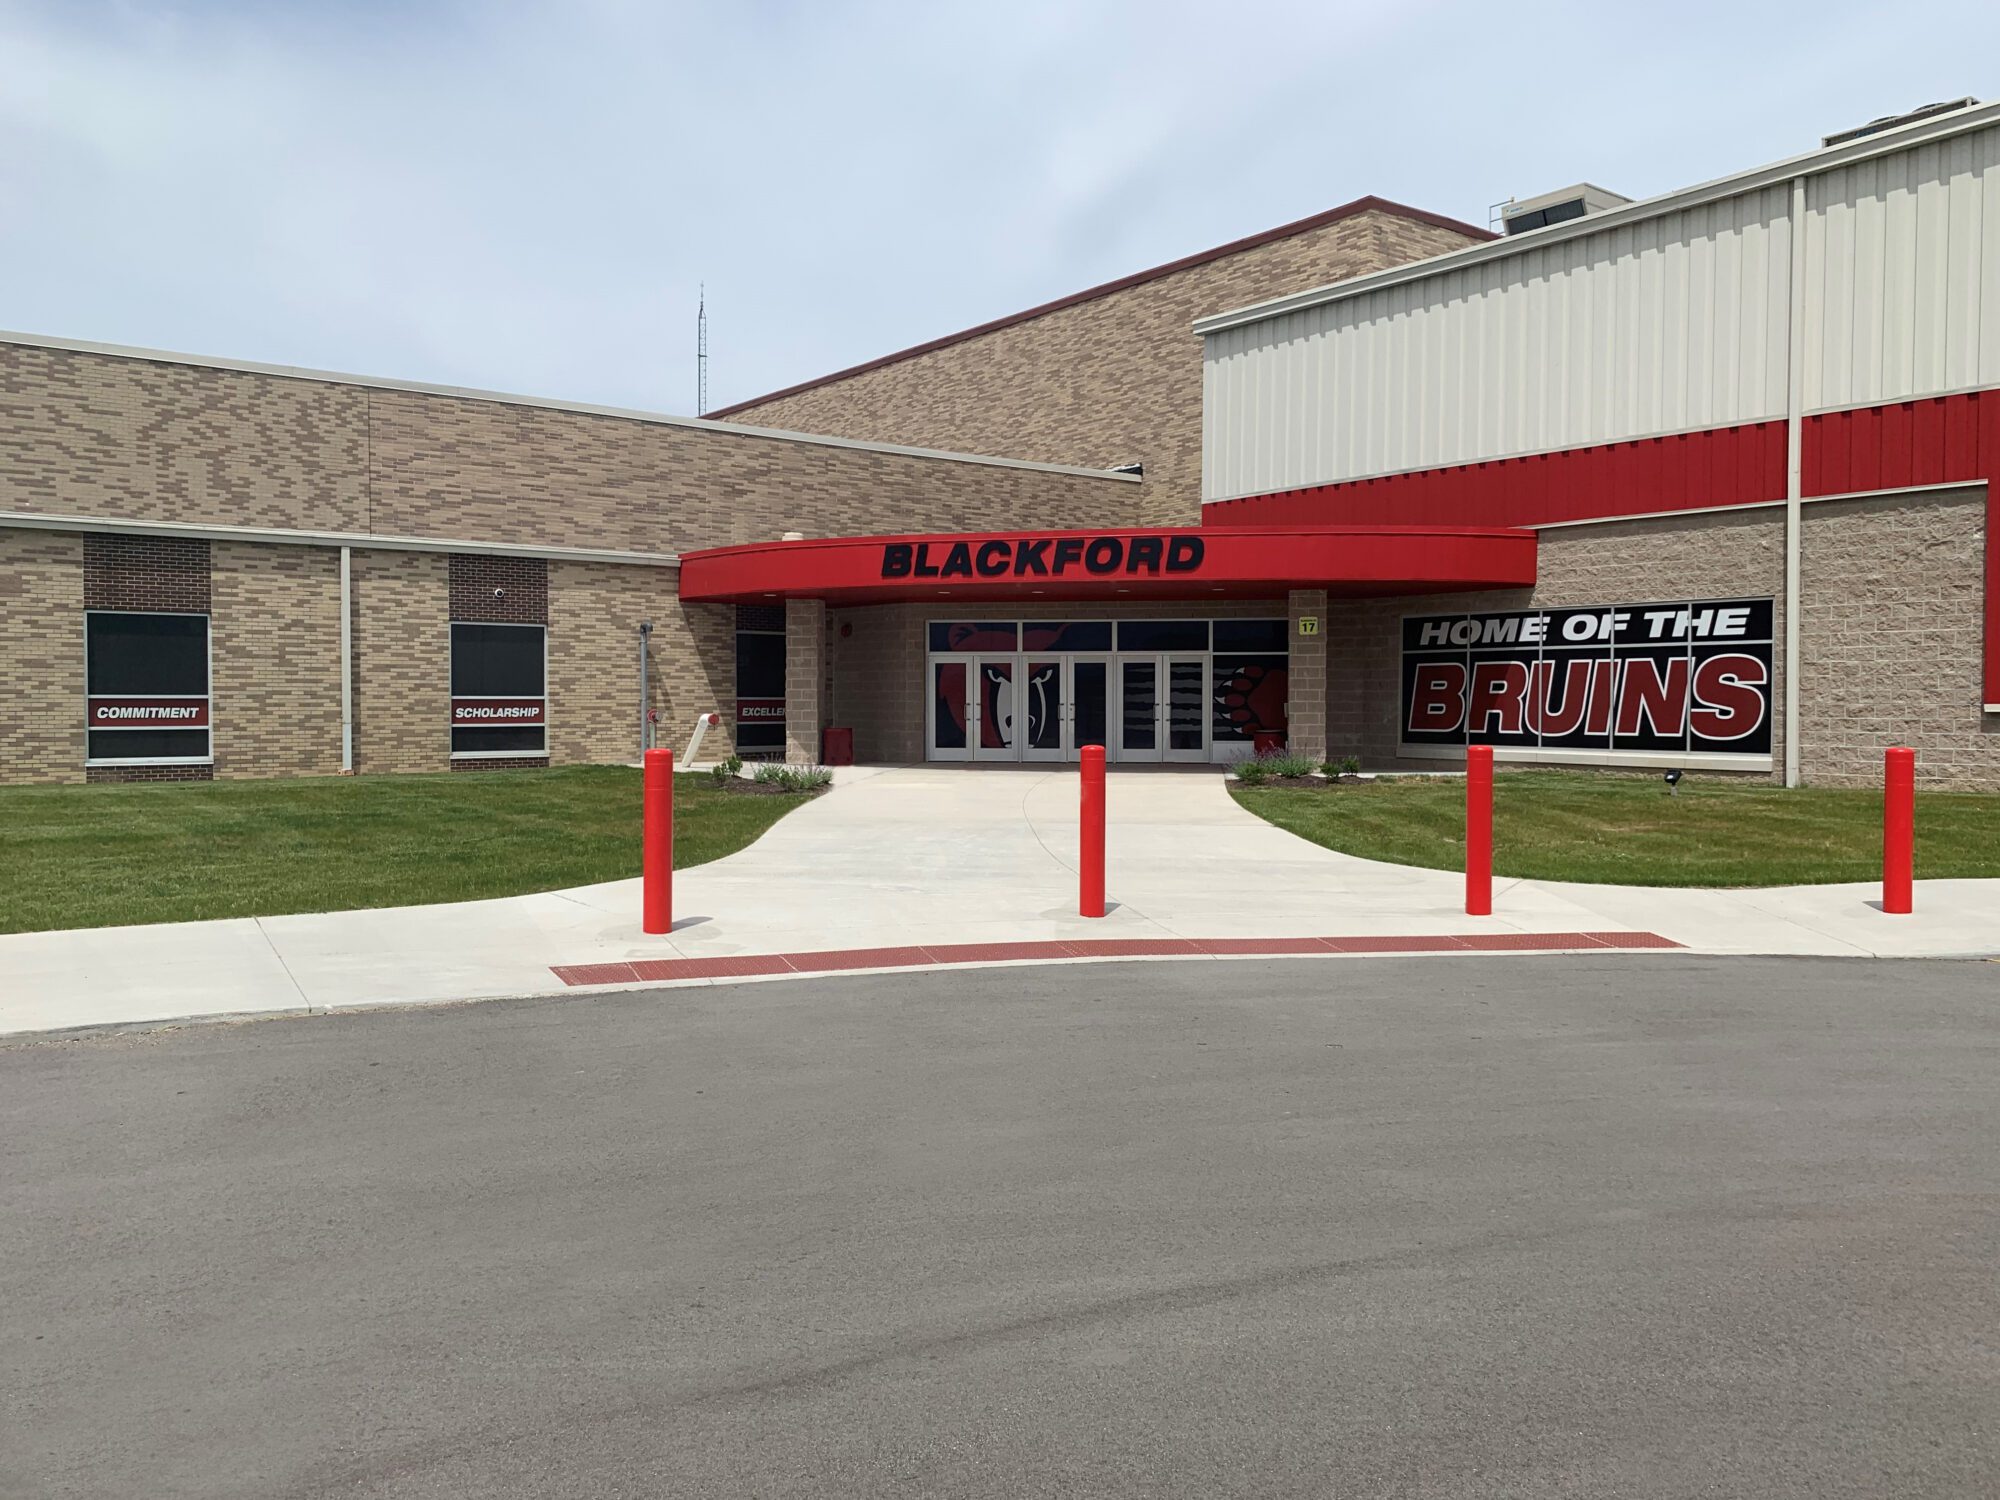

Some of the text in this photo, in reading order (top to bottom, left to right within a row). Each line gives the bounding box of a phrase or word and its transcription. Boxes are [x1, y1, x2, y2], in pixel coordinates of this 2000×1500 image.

[881, 536, 1205, 578] BLACKFORD
[1302, 622, 1315, 633] 17
[1419, 607, 1751, 646] HOME OF THE
[1407, 653, 1768, 741] BRUINS
[97, 707, 199, 719] COMMITMENT
[455, 707, 540, 719] SCHOLARSHIP
